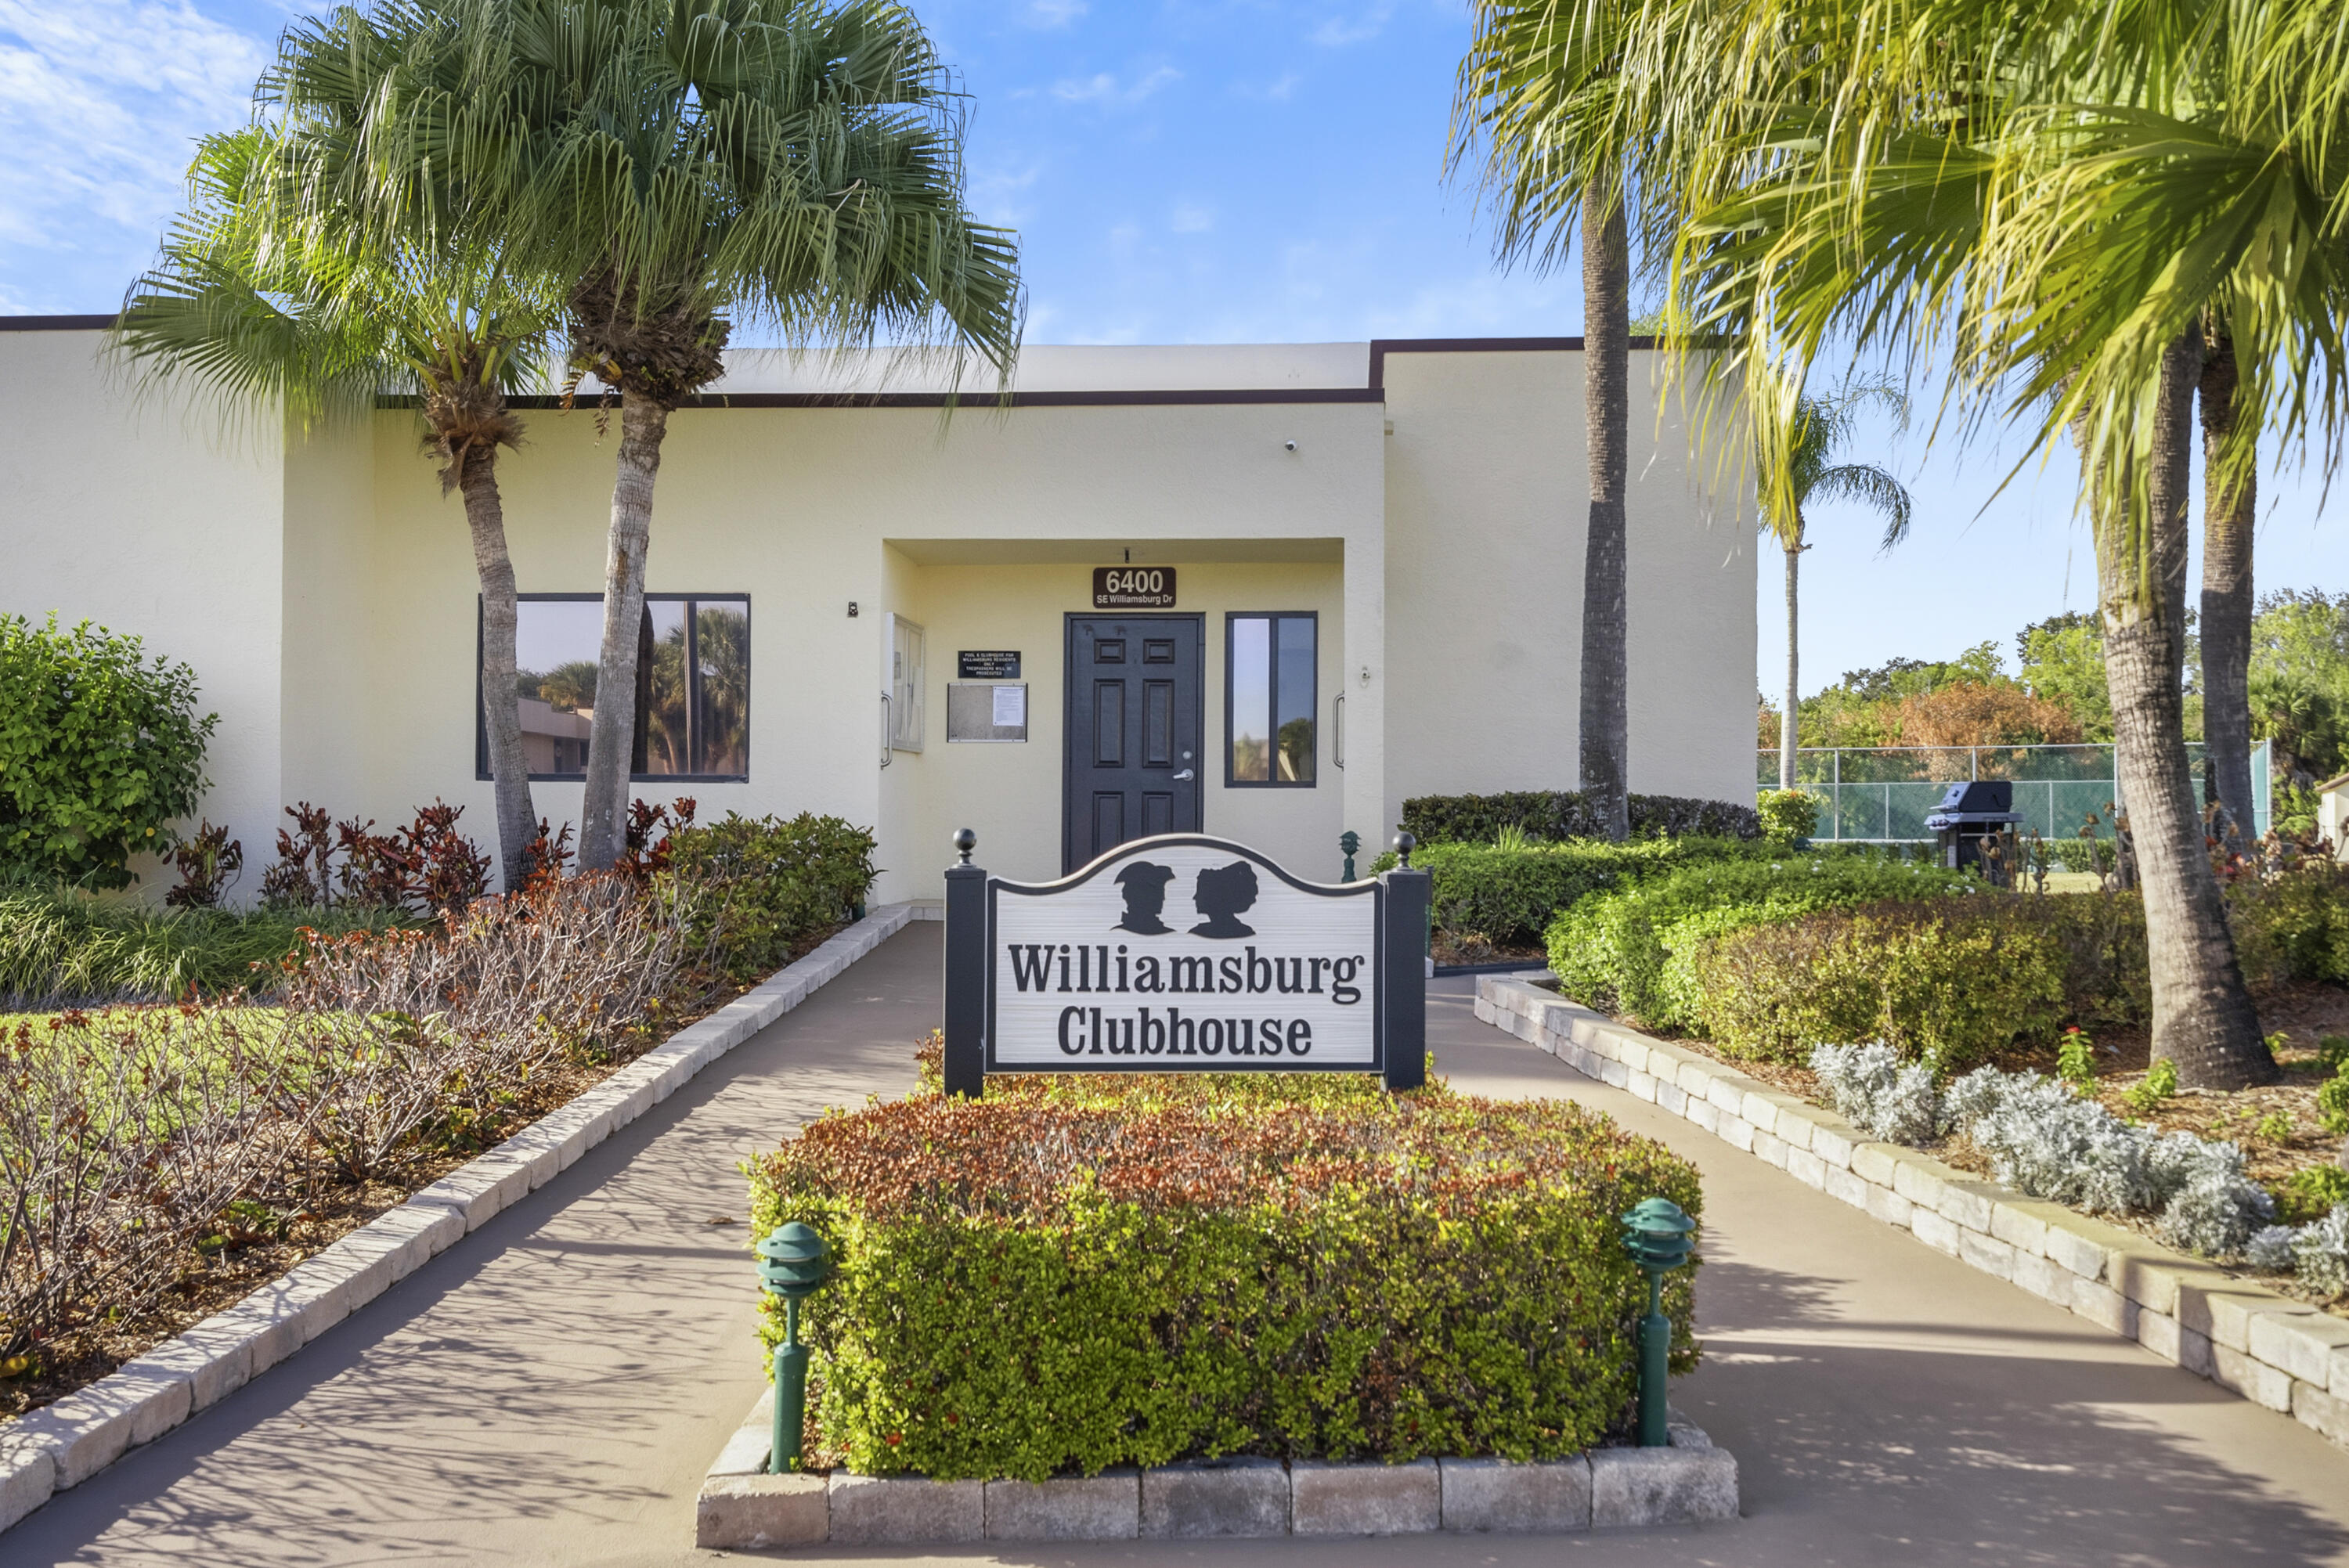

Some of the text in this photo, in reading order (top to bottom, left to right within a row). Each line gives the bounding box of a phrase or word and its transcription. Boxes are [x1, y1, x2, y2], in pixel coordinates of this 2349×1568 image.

[1097, 595, 1108, 604] SE
[1110, 595, 1160, 605] Williamsburg
[1106, 570, 1163, 593] 6400
[1008, 944, 1365, 1005] Williamsburg
[1058, 1005, 1312, 1056] Clubhouse
